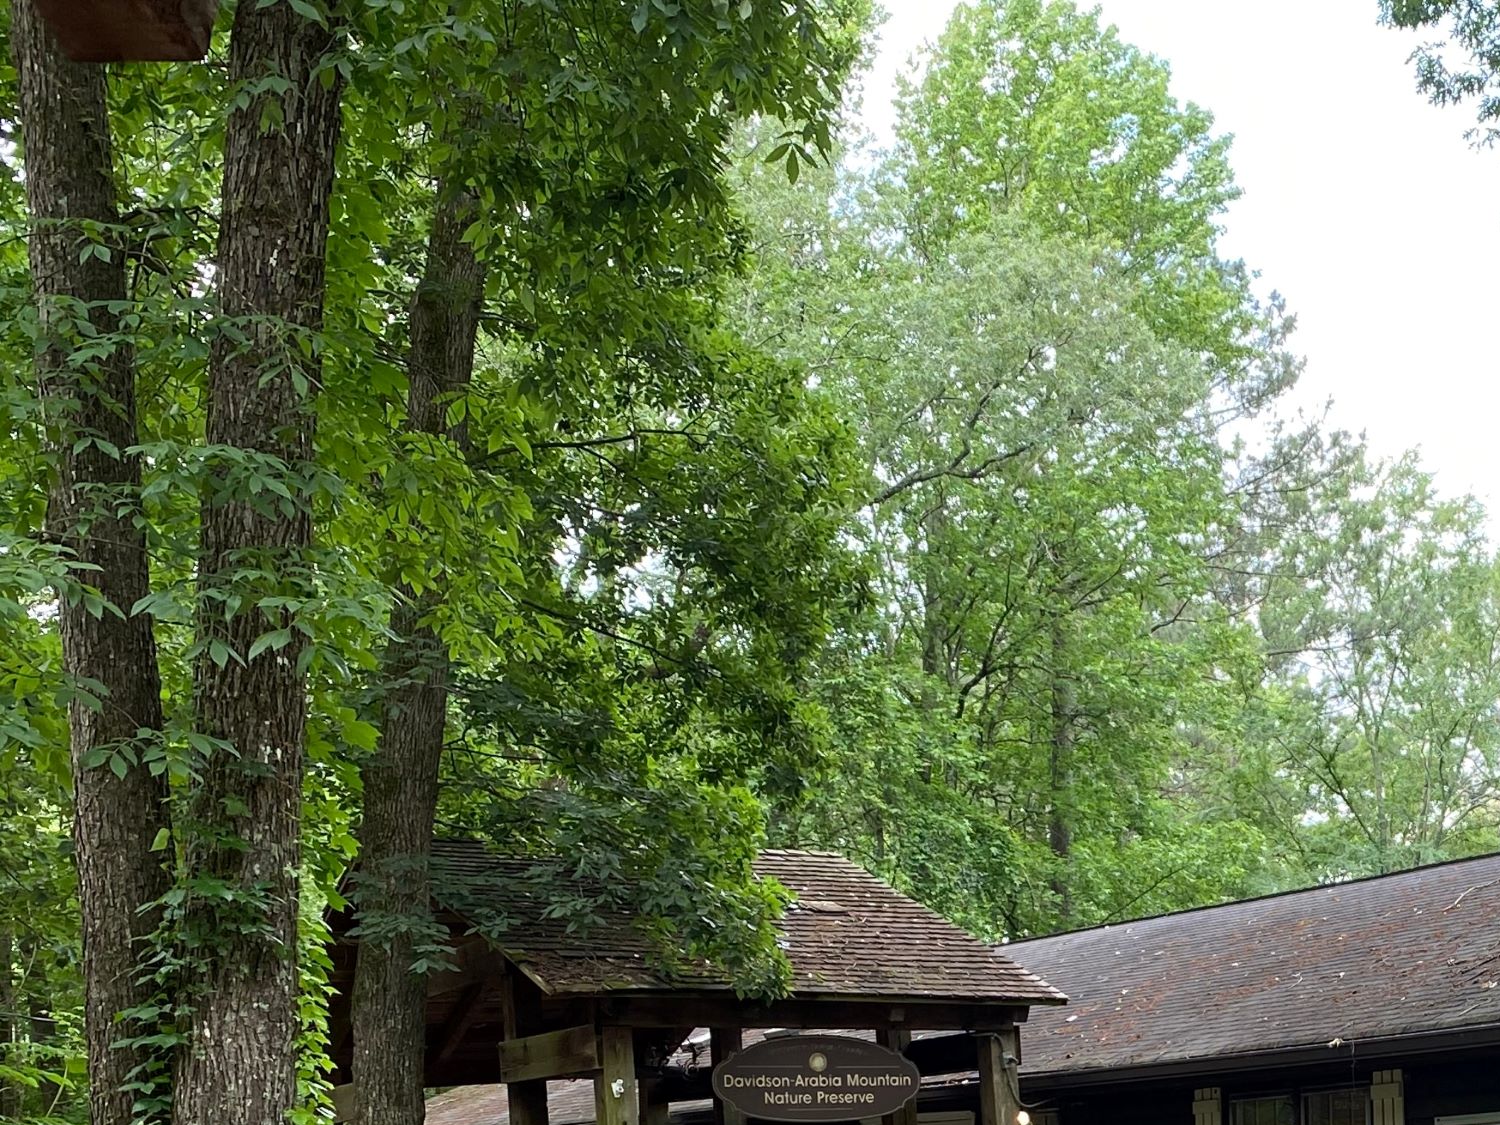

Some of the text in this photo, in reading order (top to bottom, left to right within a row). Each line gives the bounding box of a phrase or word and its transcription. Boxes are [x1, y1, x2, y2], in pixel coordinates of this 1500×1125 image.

[723, 1073, 912, 1088] Davidson-Arabia Mountain
[764, 1091, 875, 1105] Nature Preserve
